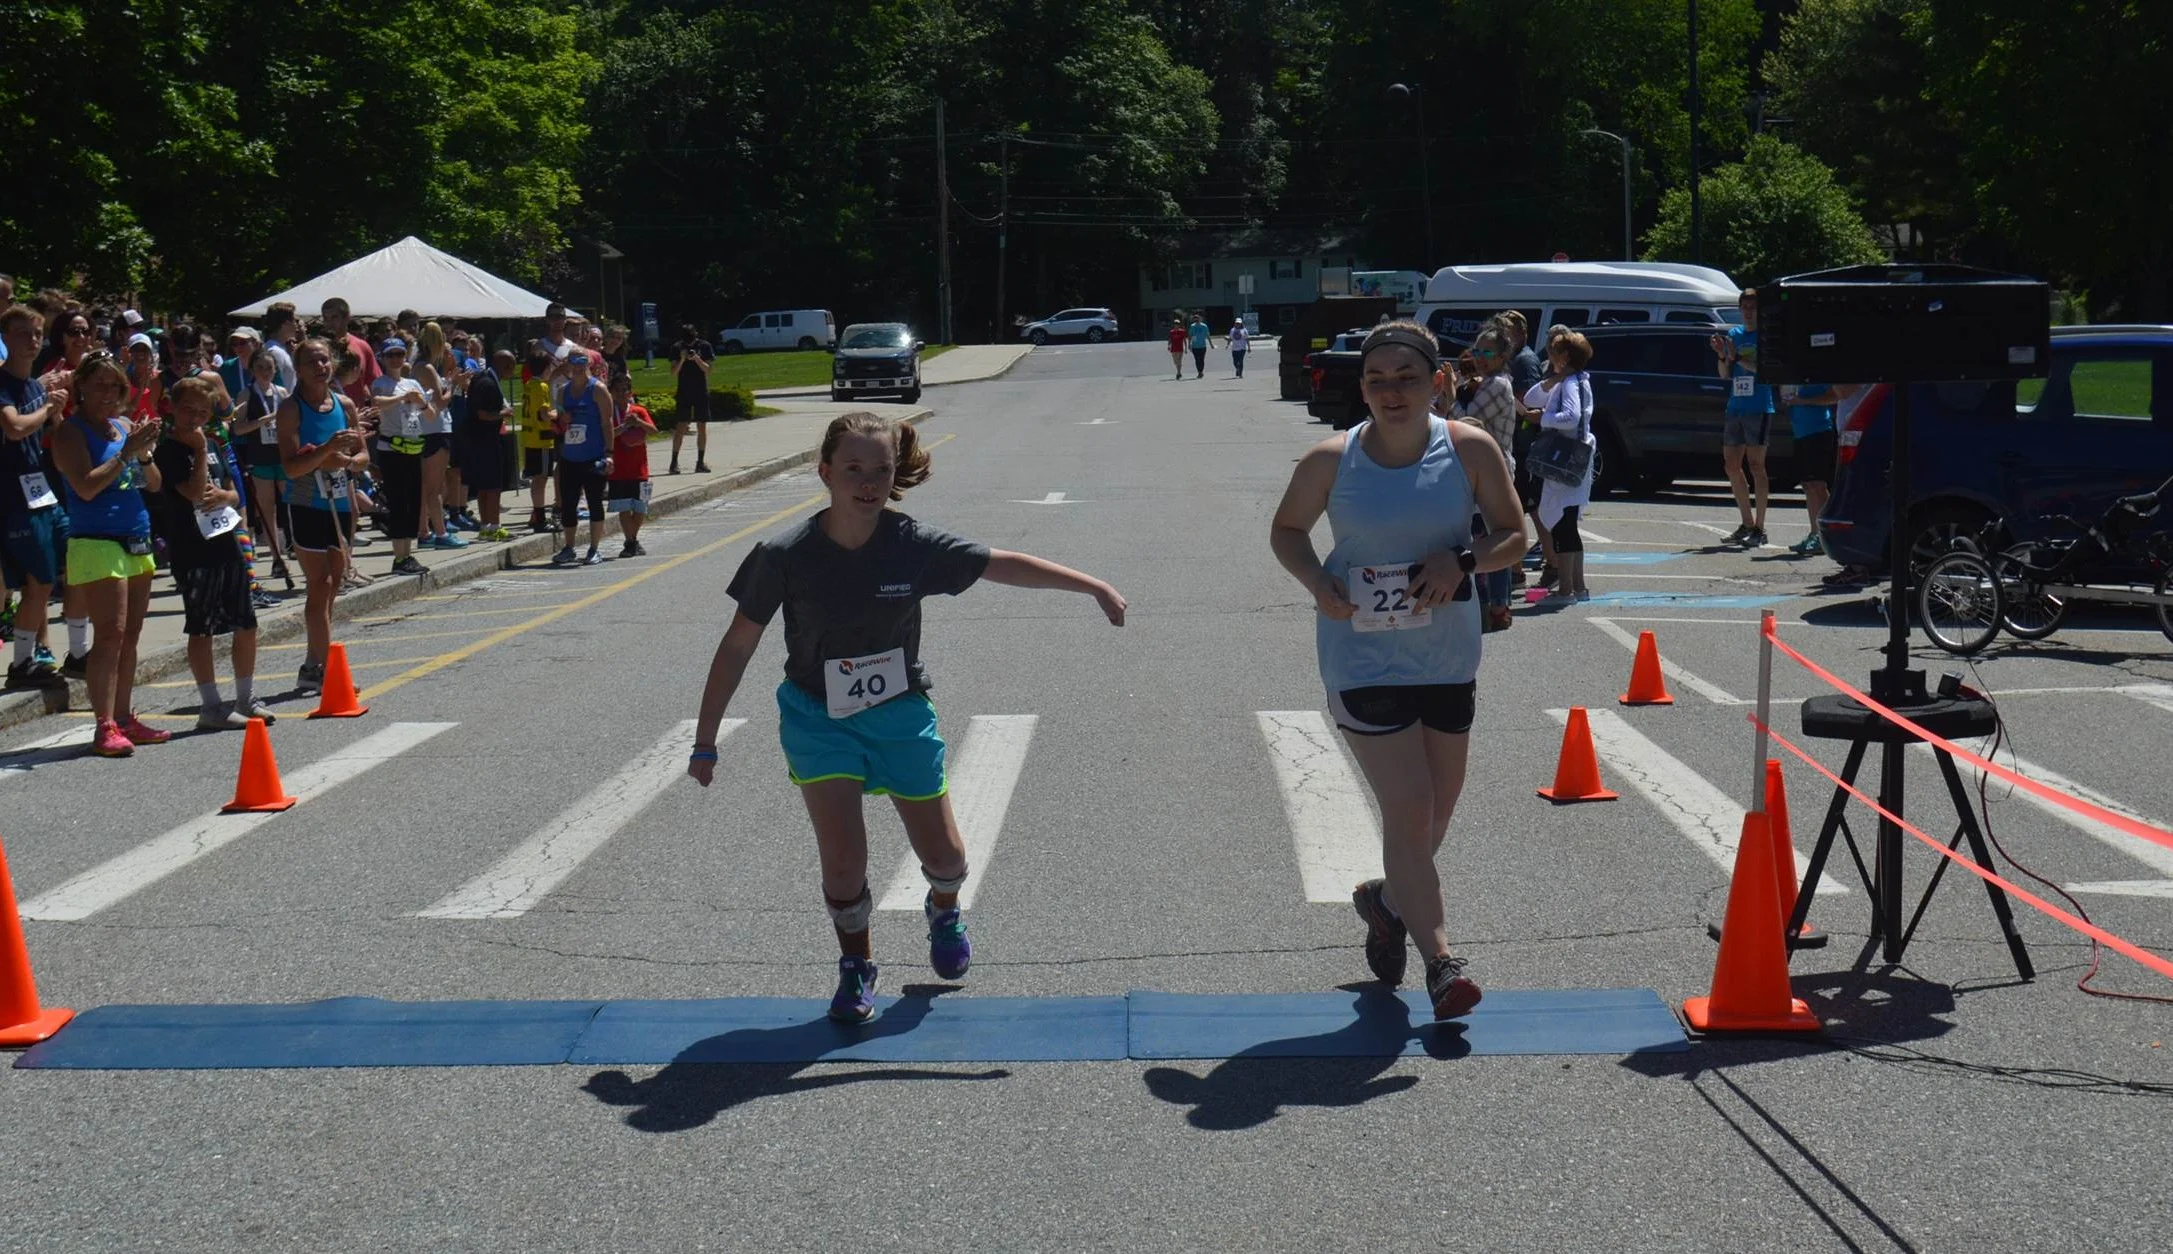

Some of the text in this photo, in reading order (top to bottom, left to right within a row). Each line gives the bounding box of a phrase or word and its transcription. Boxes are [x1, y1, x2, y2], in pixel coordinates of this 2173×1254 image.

[30, 485, 43, 498] 68
[210, 515, 230, 529] 69
[1377, 569, 1407, 579] RaceWi
[880, 583, 911, 592] UNIFIED
[1373, 588, 1409, 612] 22
[855, 656, 891, 671] RaceWire
[847, 673, 886, 699] 40
